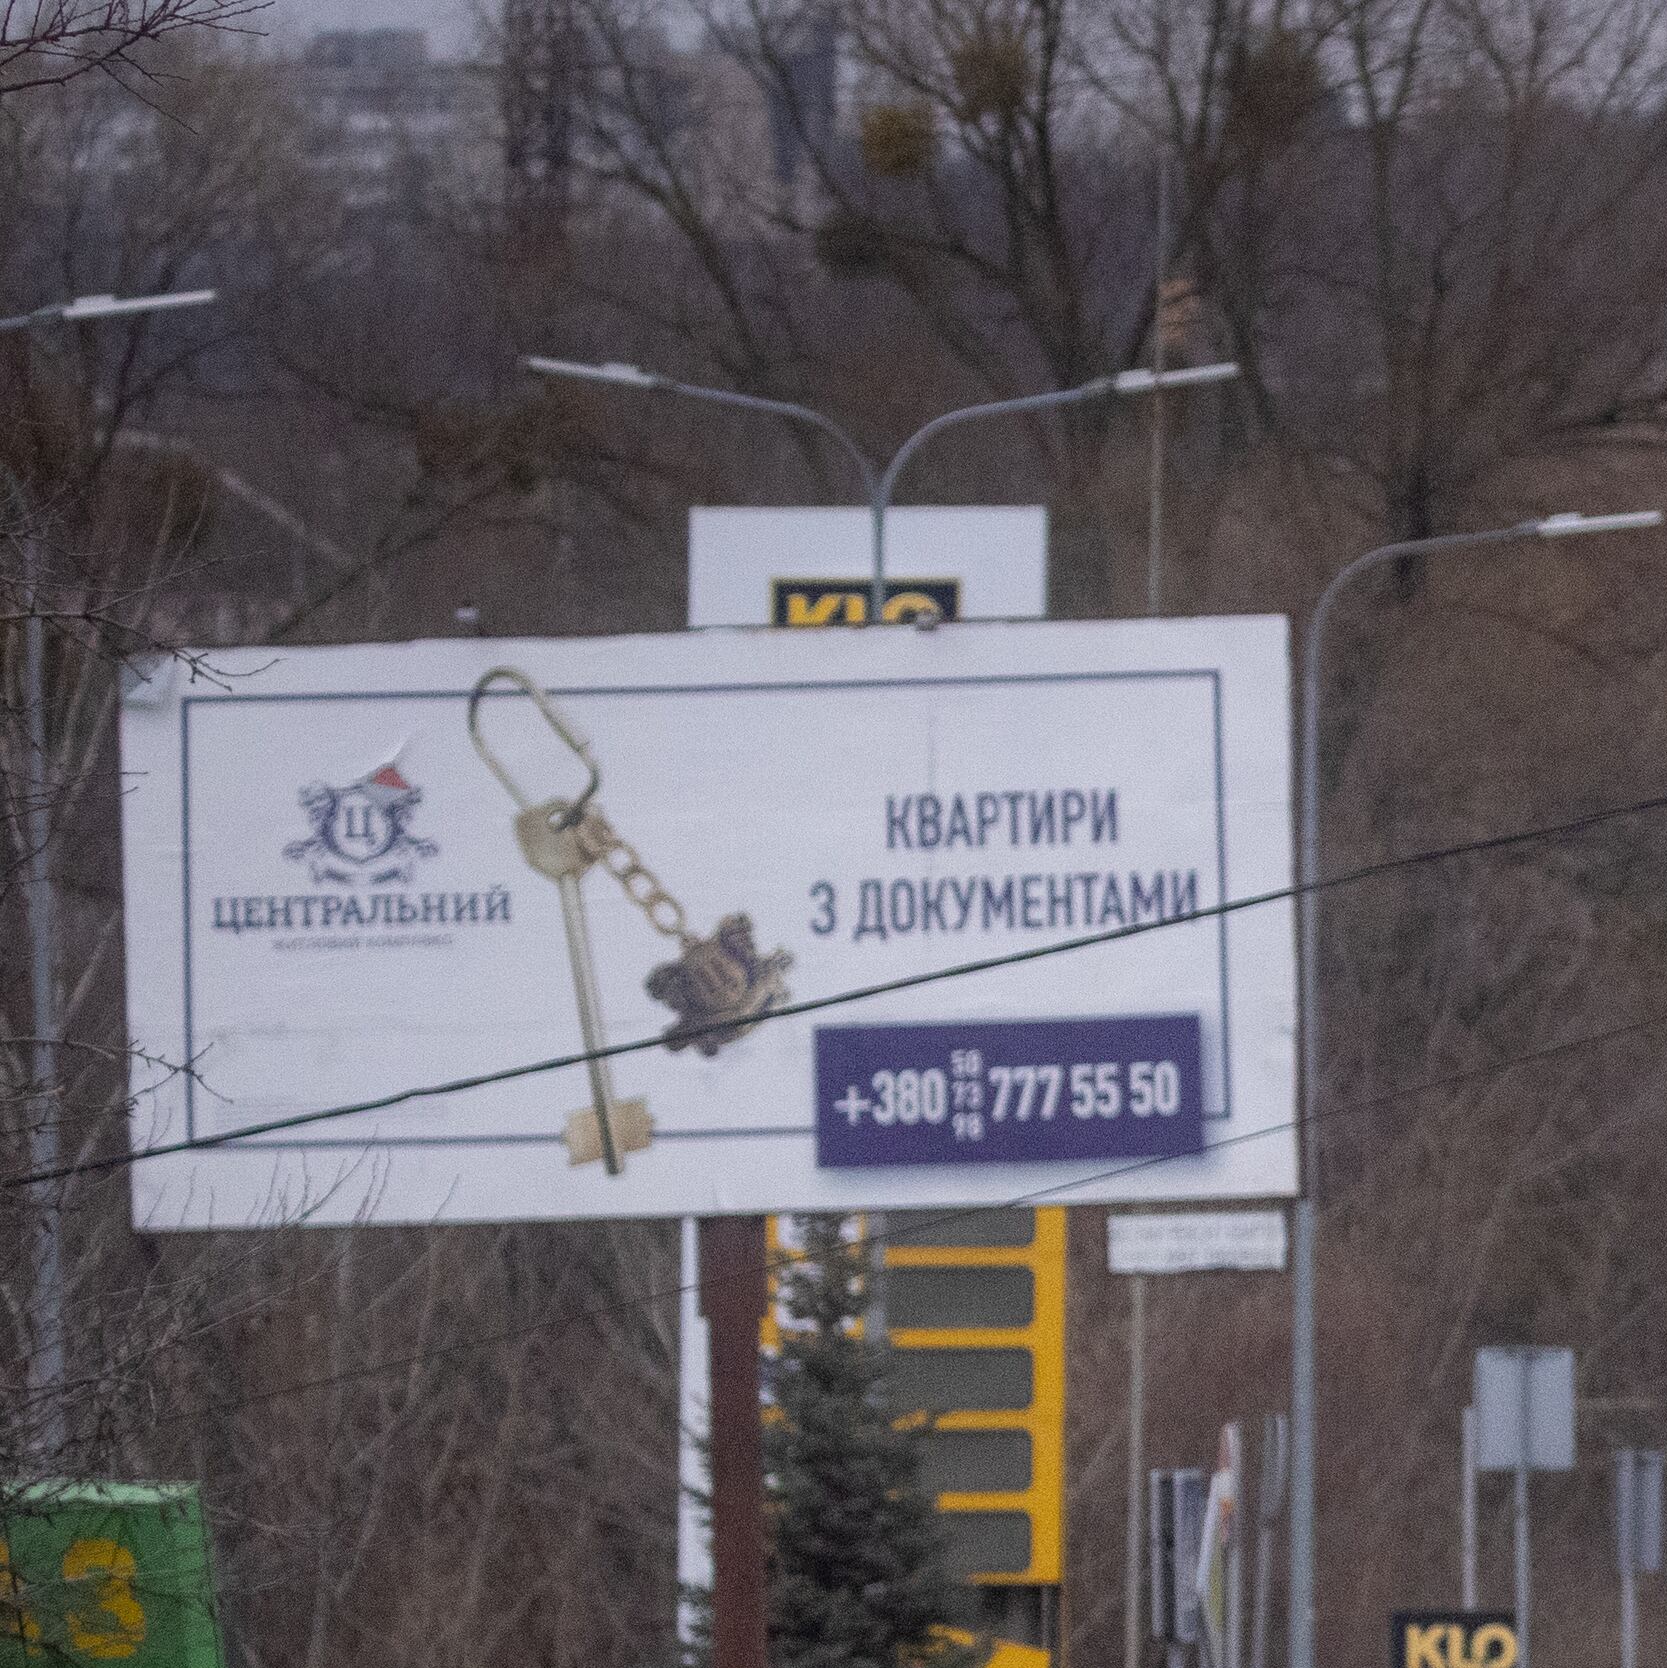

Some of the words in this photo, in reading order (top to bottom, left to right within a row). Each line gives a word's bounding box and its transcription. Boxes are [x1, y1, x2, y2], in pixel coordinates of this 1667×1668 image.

[885, 788, 1120, 850] КВАРТИРИ
[212, 886, 511, 935] ЦЕНТРАЛЬНИЙ
[809, 880, 838, 935] З
[854, 869, 1202, 942] ДОКУМЕНТАМИ
[835, 1066, 947, 1126] +380
[988, 1065, 1064, 1120] 777
[1071, 1063, 1120, 1116] 55
[1129, 1060, 1181, 1115] 50
